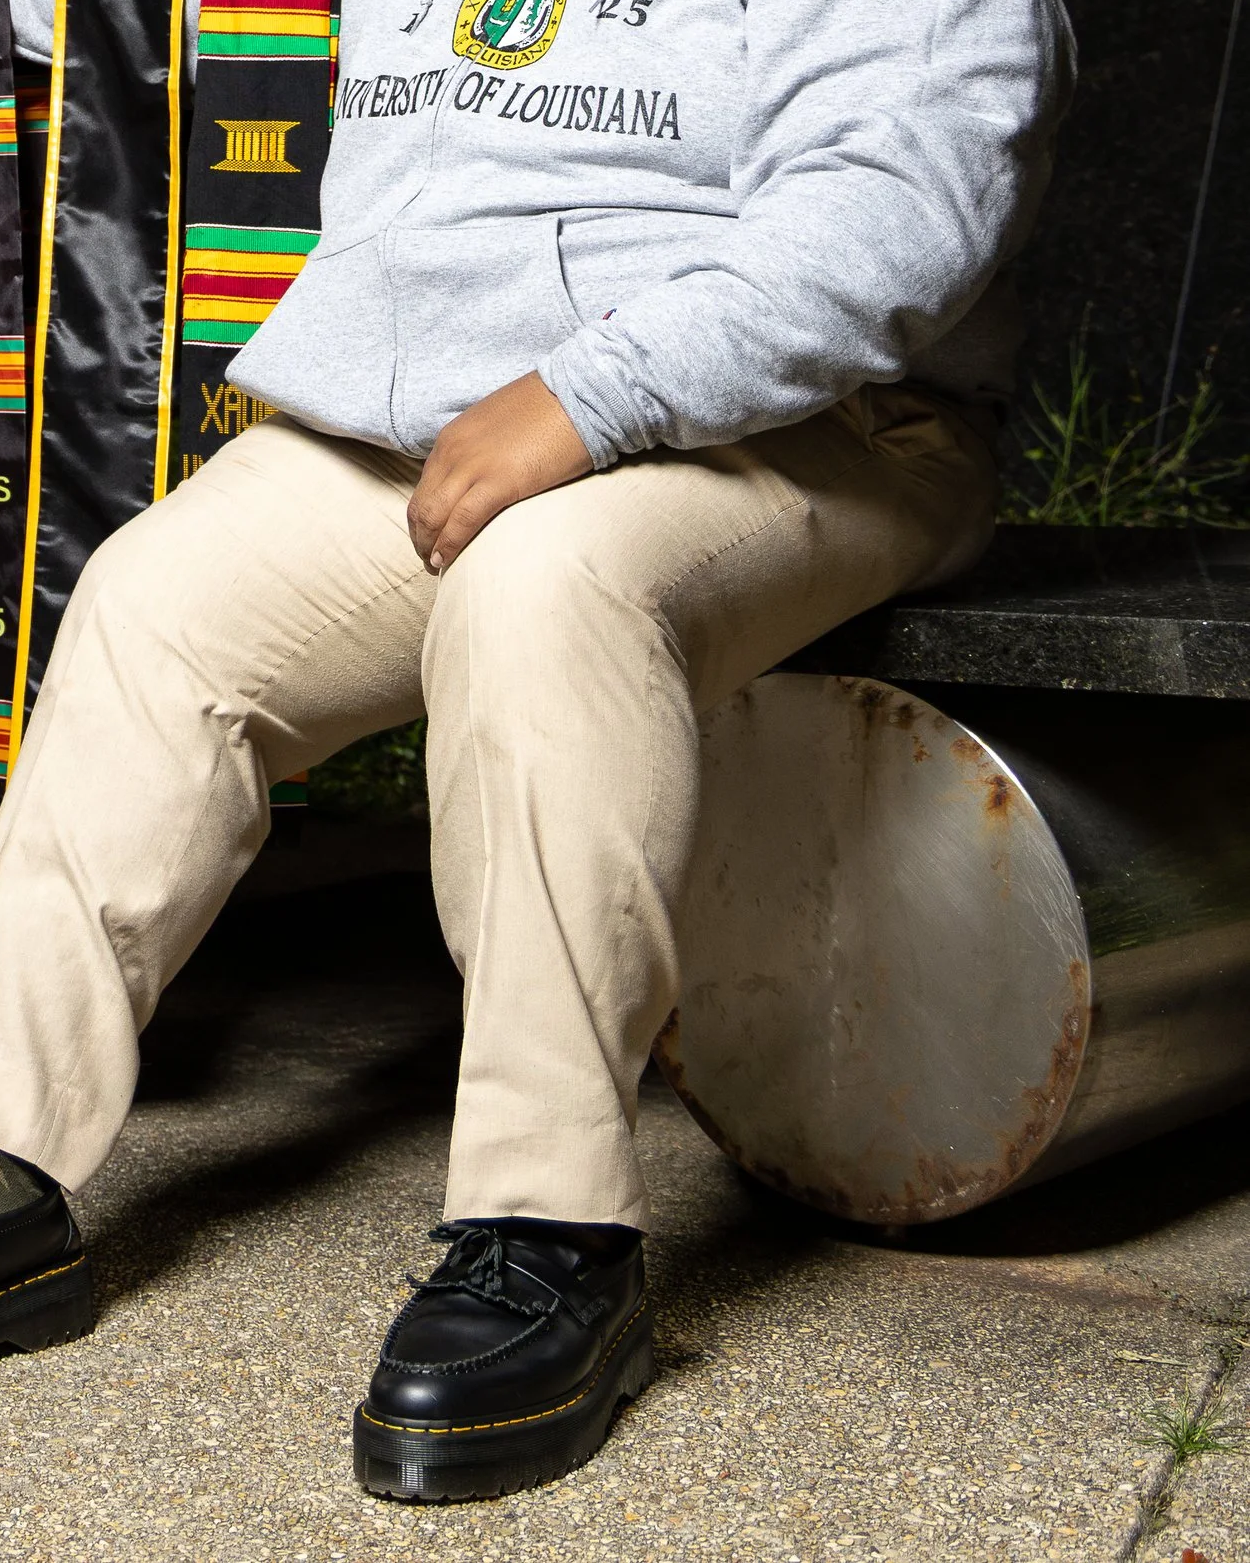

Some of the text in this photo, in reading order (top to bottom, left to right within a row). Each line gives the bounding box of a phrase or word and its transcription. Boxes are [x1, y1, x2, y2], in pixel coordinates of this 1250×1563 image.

[465, 38, 551, 66] OUISIANA
[336, 65, 682, 141] NIVERSITY OF LOUISIANA
